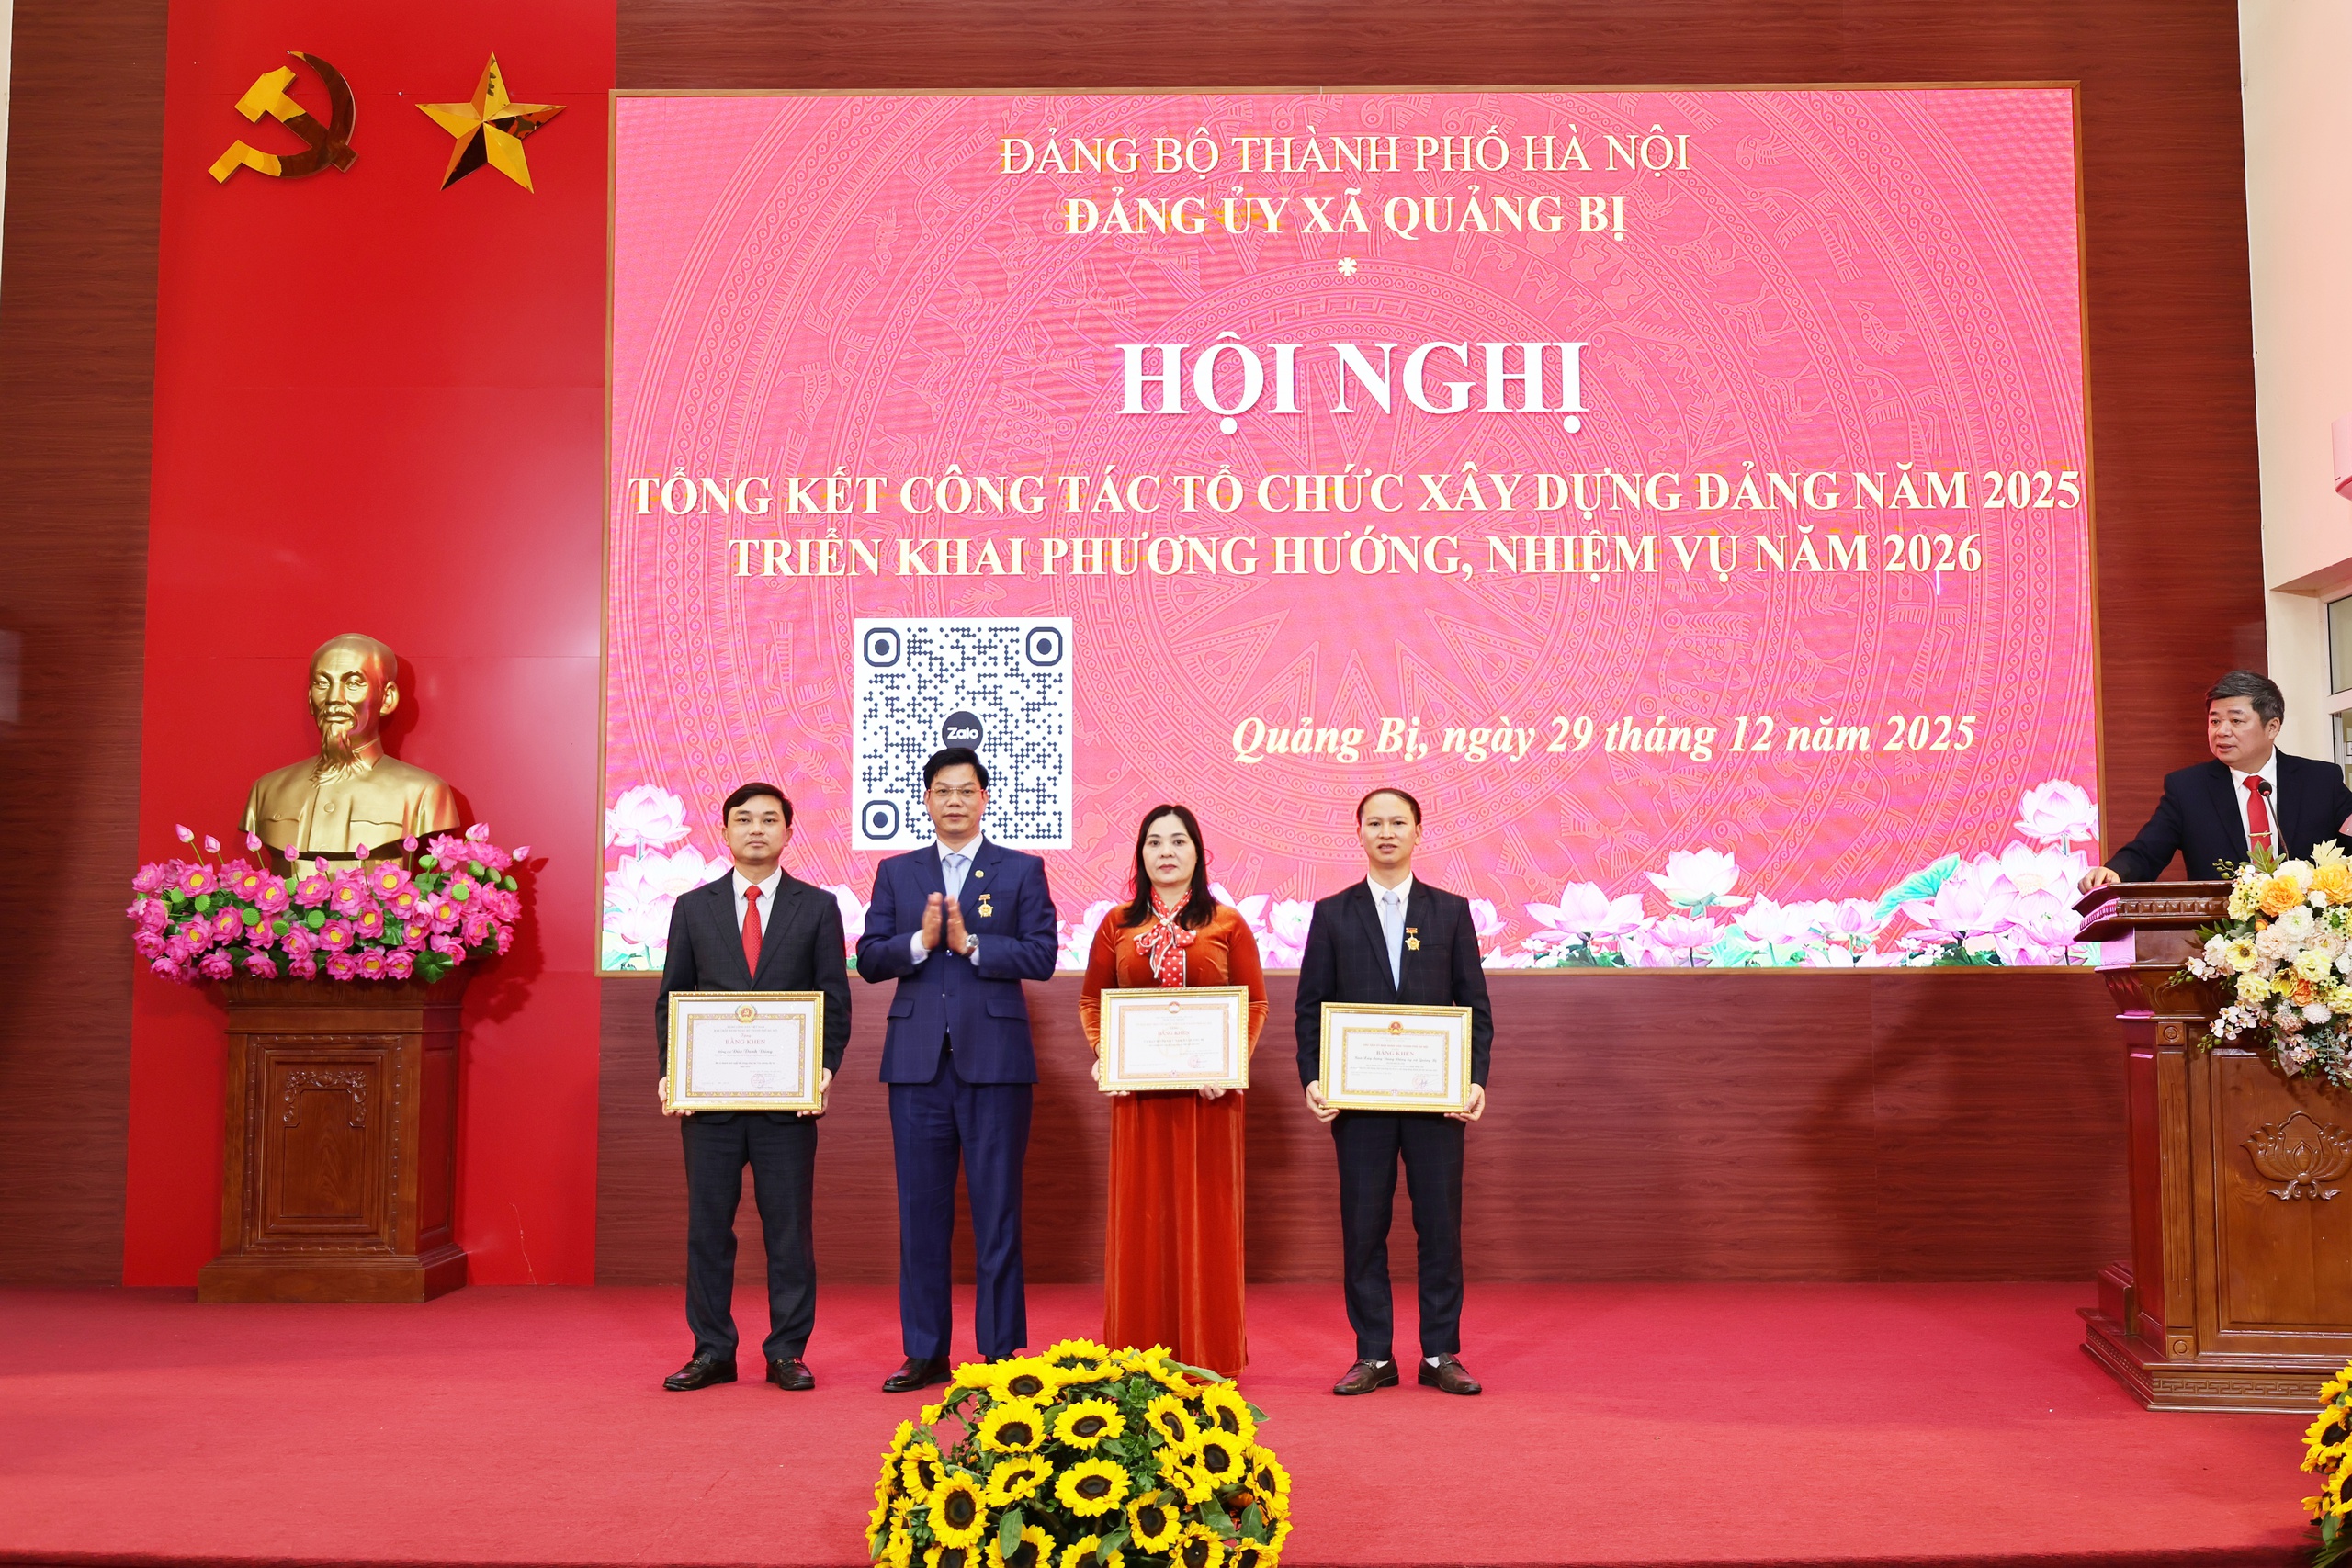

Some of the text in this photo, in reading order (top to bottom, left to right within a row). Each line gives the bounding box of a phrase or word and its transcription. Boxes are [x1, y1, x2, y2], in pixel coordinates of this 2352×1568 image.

[1001, 124, 1690, 179] ĐẢNG BỘ THÀNH PHỐ HÀ NỘI
[1065, 186, 1627, 241] ĐẢNG ỦY XÃ QUẢNG BỊ
[1115, 332, 1589, 434] HỘI NGHỊ
[628, 461, 2079, 520] TỔNG KẾT CÔNG TÁC TỔ CHỨC XÂY DỰNG ĐẢNG NĂM 2025
[729, 525, 1981, 582] TRIỂN KHAI PHƯƠNG HƯỚNG, NHIỆM VỤ NĂM 2026
[946, 726, 979, 740] Zalo
[1233, 716, 1975, 763] Quảng Bị, ngày 29 tháng 12 năm 2025
